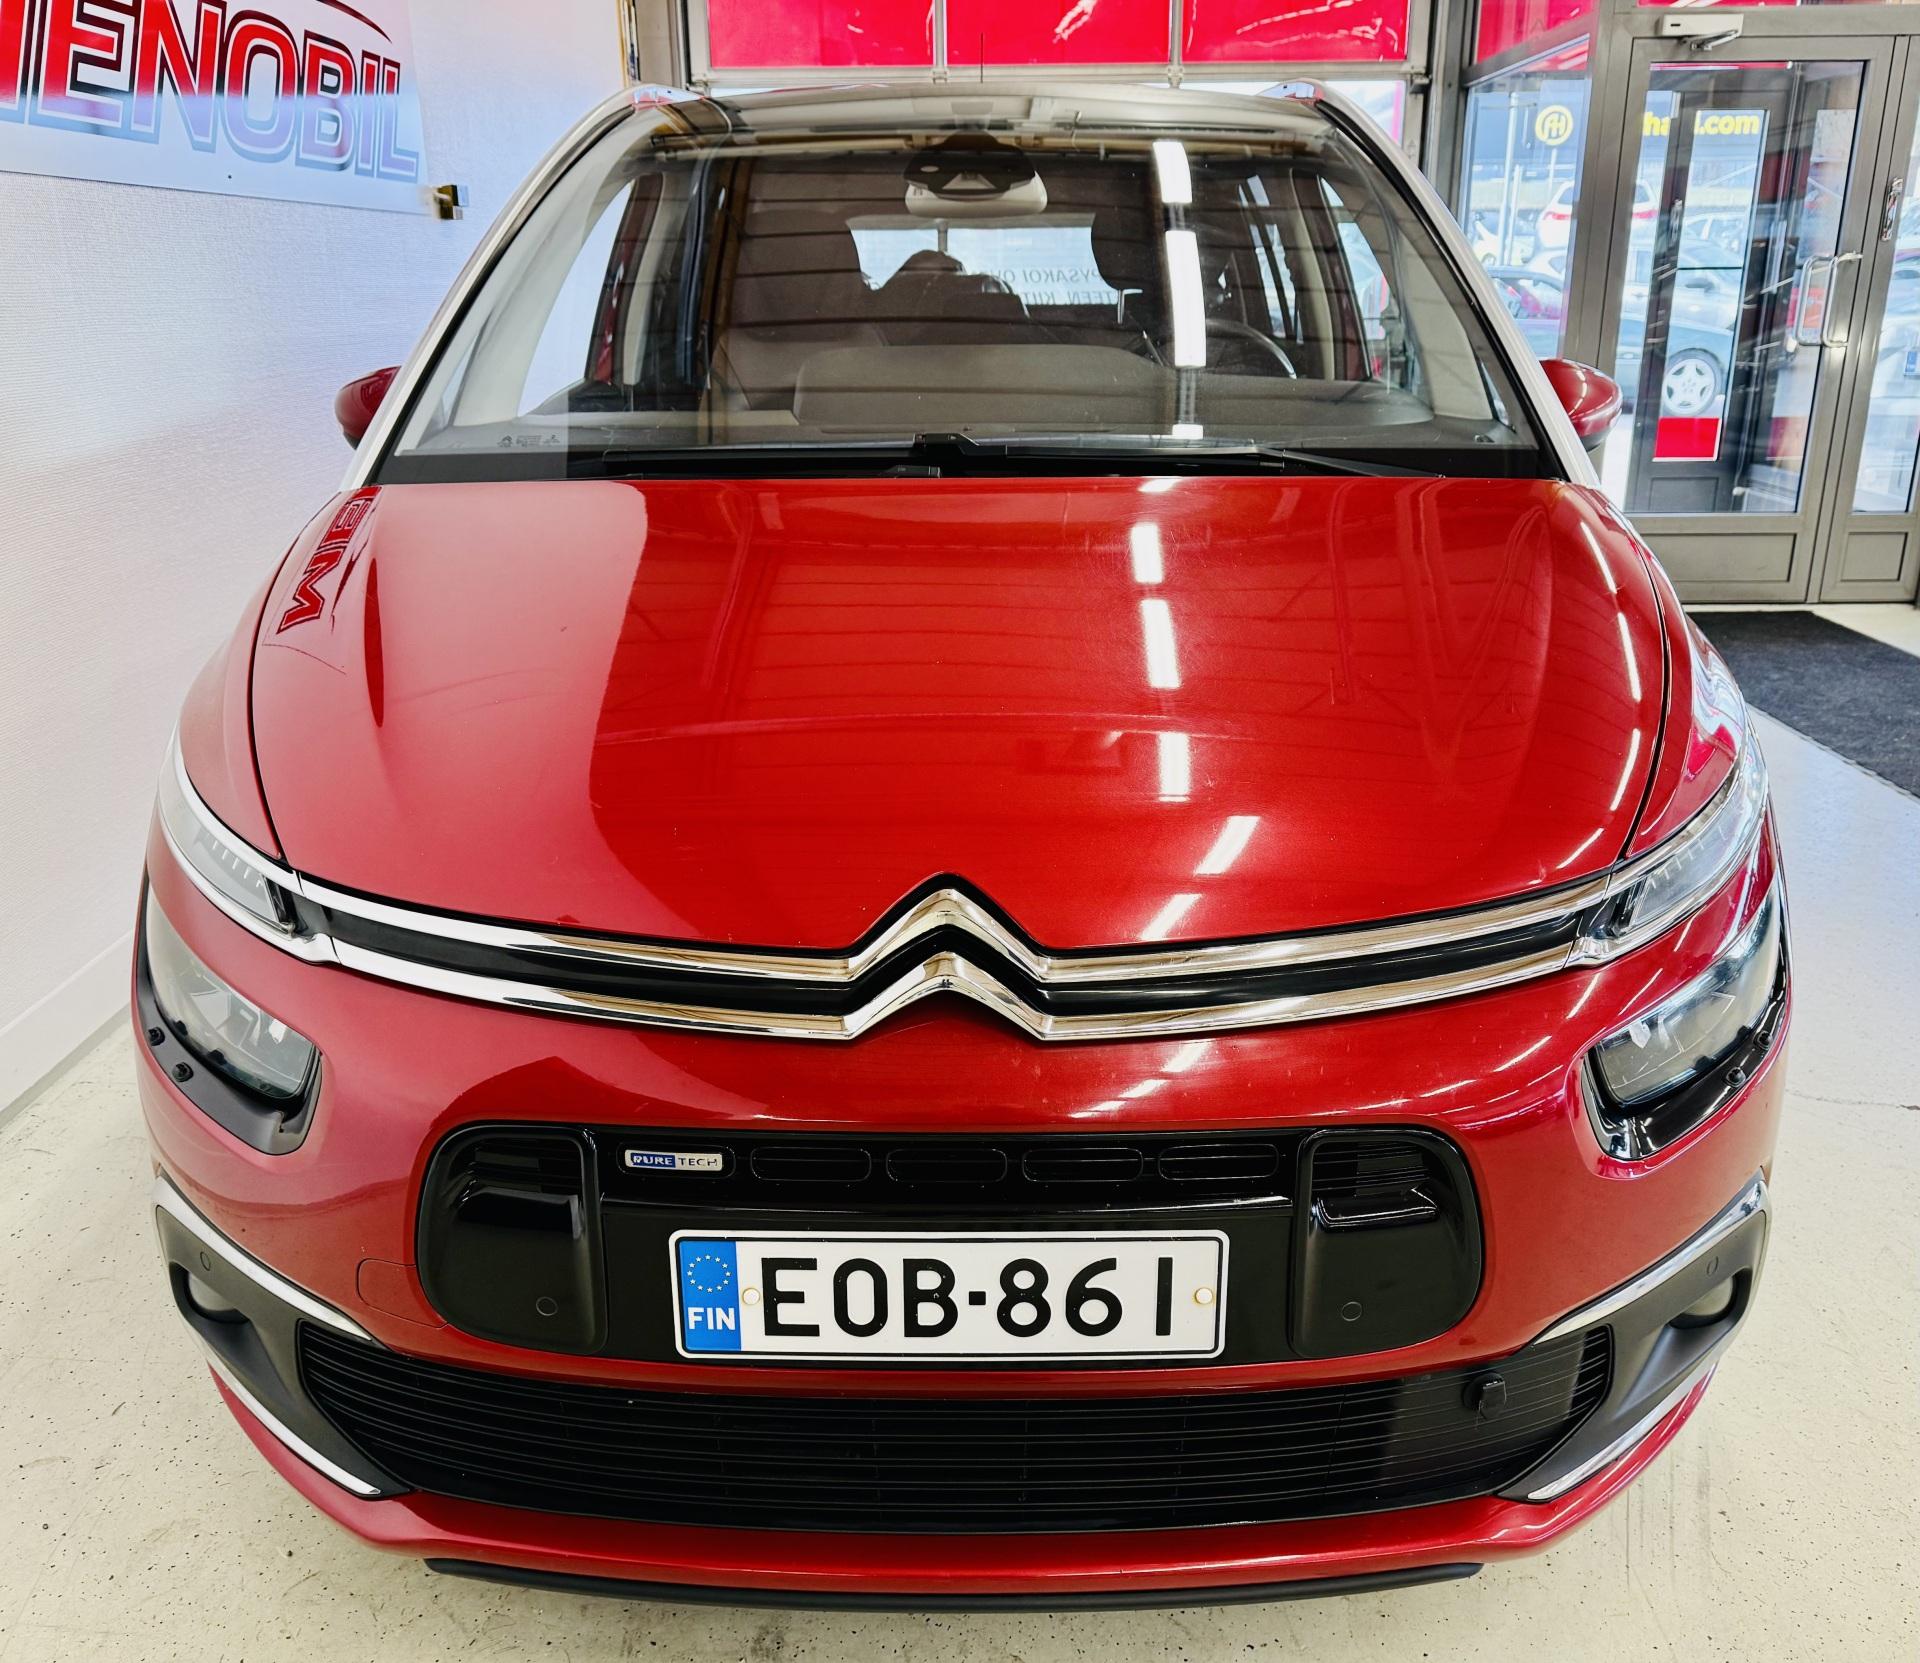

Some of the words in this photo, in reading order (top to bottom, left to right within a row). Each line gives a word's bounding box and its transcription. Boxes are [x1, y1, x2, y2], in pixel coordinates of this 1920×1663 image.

[631, 1154, 674, 1167] PURE
[677, 1157, 718, 1168] TECH
[761, 1256, 1174, 1338] EOB-861
[687, 1306, 736, 1331] FIN
